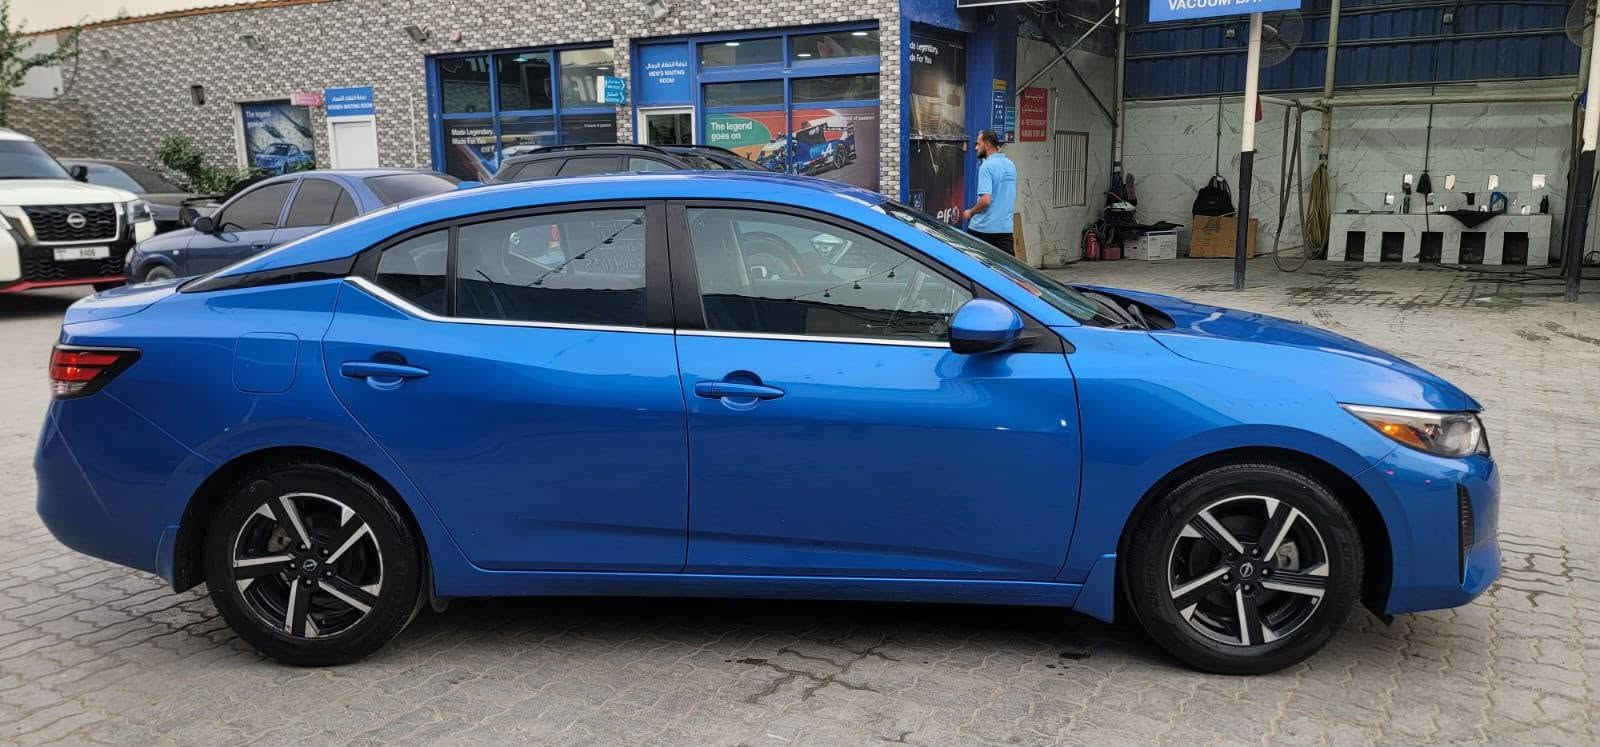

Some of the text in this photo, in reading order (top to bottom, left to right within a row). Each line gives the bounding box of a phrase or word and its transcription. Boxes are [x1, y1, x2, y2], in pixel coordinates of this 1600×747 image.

[711, 120, 753, 132] The legend
[711, 133, 729, 142] goes
